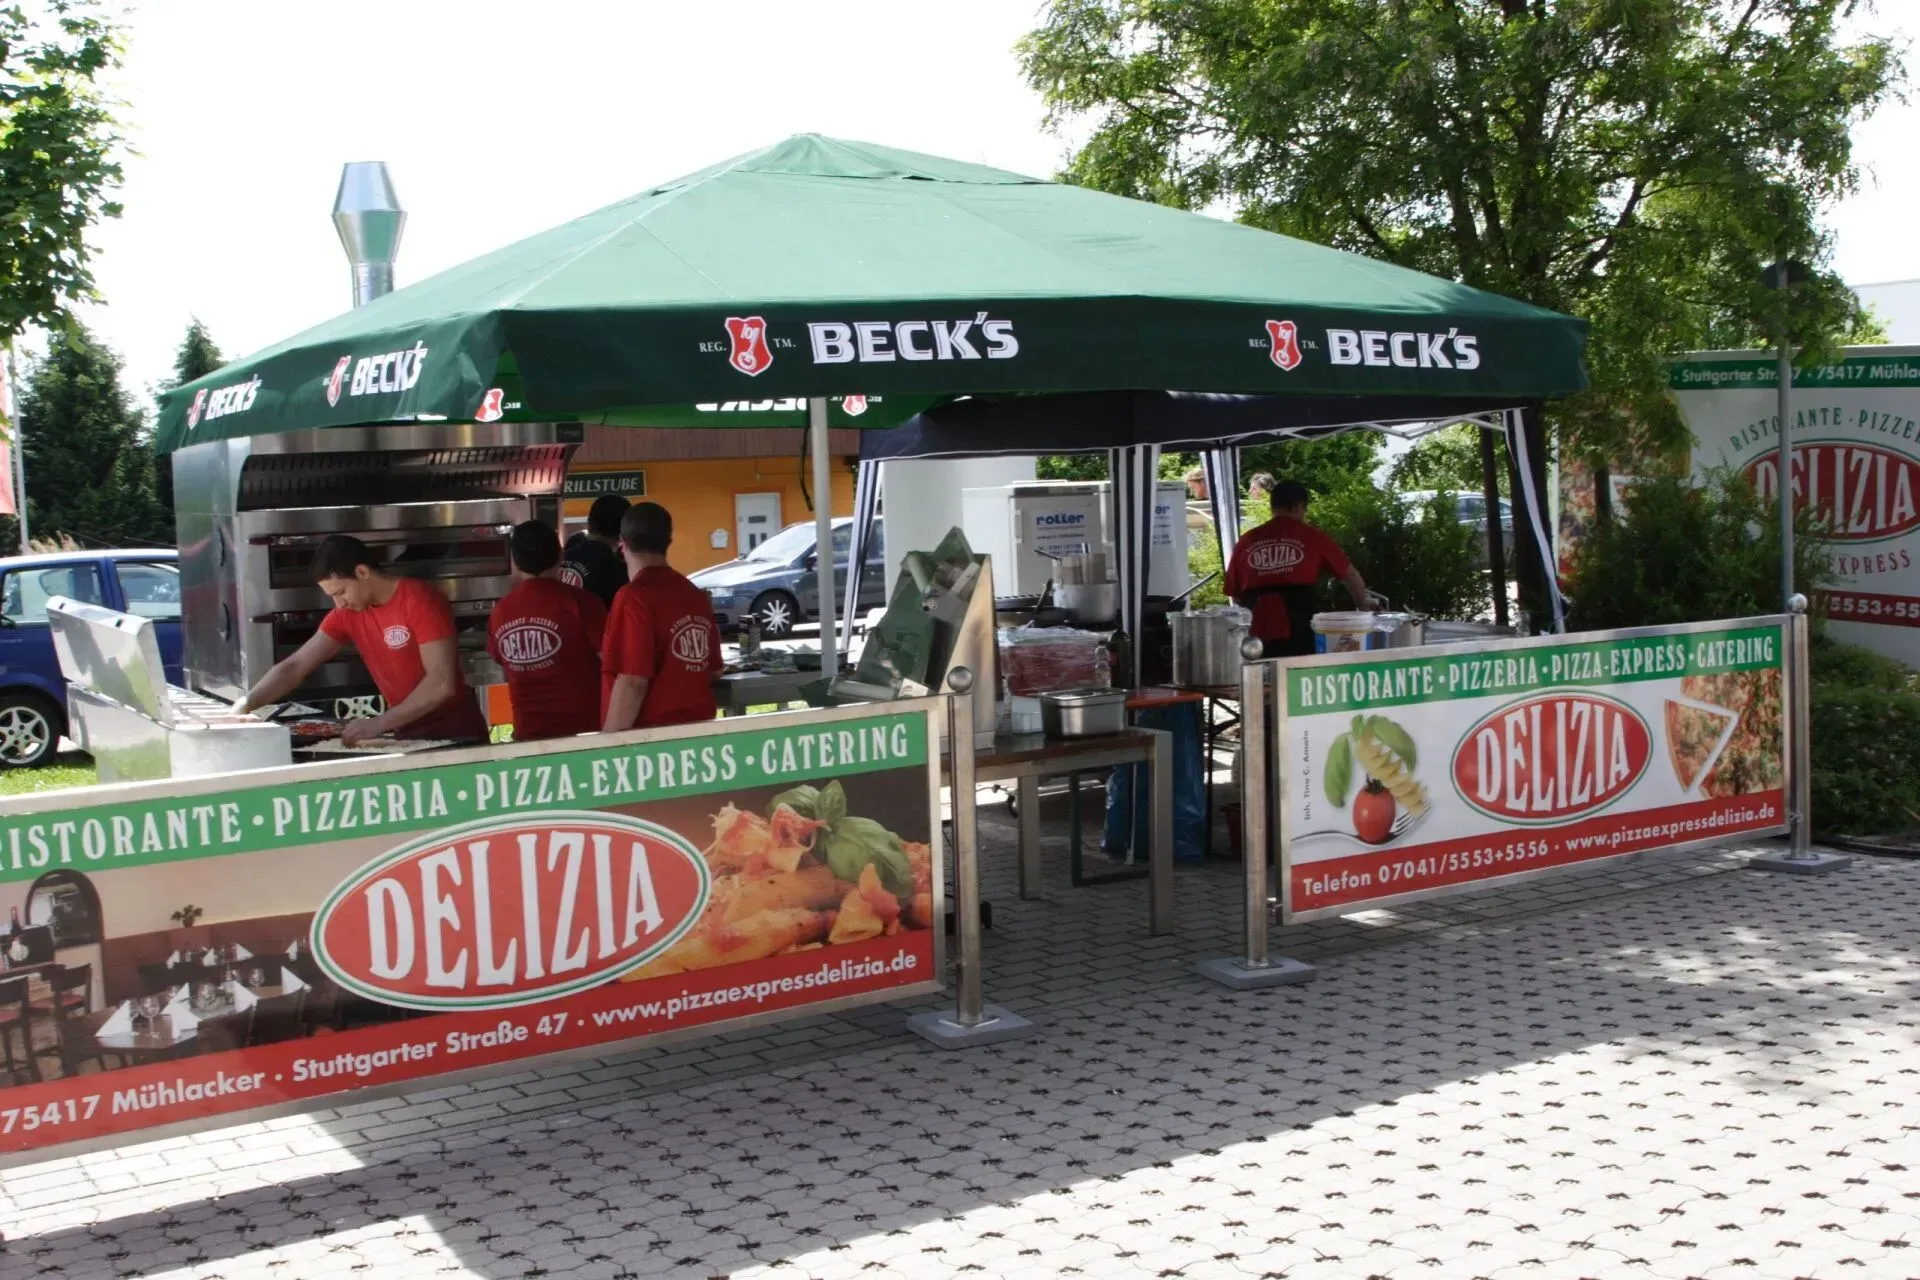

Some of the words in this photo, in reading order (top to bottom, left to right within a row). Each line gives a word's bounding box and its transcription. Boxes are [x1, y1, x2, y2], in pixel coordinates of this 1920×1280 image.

[699, 340, 727, 353] REG.
[773, 337, 796, 349] TM.
[807, 311, 1019, 364] BECK'S
[1248, 338, 1270, 349] REG.
[1301, 339, 1319, 350] TM.
[1326, 327, 1480, 370] BECK'S
[350, 339, 428, 396] BECK'S
[1682, 367, 1752, 385] Stuttgarter
[1757, 366, 1779, 381] Str.
[1816, 364, 1865, 380] 75417
[1869, 361, 1920, 379] Mühla
[205, 373, 263, 420] BECK'S
[1730, 407, 1842, 452] RISTOANTE
[503, 630, 552, 660] DELIZIA
[1300, 664, 1434, 707] RISTORANTE
[1448, 656, 1539, 692] PIZZERIA
[1551, 643, 1686, 682] PIZZA-EXPRESS
[1696, 635, 1773, 668] CATERING
[1476, 700, 1631, 812] DELIZIA
[0, 802, 242, 871] ISTORANTE
[272, 778, 449, 837] PIZZERIA
[475, 743, 738, 811] PIZZA-EXPRESS
[761, 723, 909, 775] CATERING
[1303, 872, 1371, 896] Telefon
[1565, 802, 1775, 850] www.pizzaexpressdelizia.de
[364, 829, 664, 990] DELIZIA
[1, 1094, 101, 1134] 75417
[112, 1070, 266, 1115] Mühlacker
[292, 1040, 438, 1082] Stuttgarter
[446, 1020, 529, 1054] Straße
[536, 1012, 569, 1037] 47
[593, 949, 918, 1027] www.pizzaexpressdelizia.de
